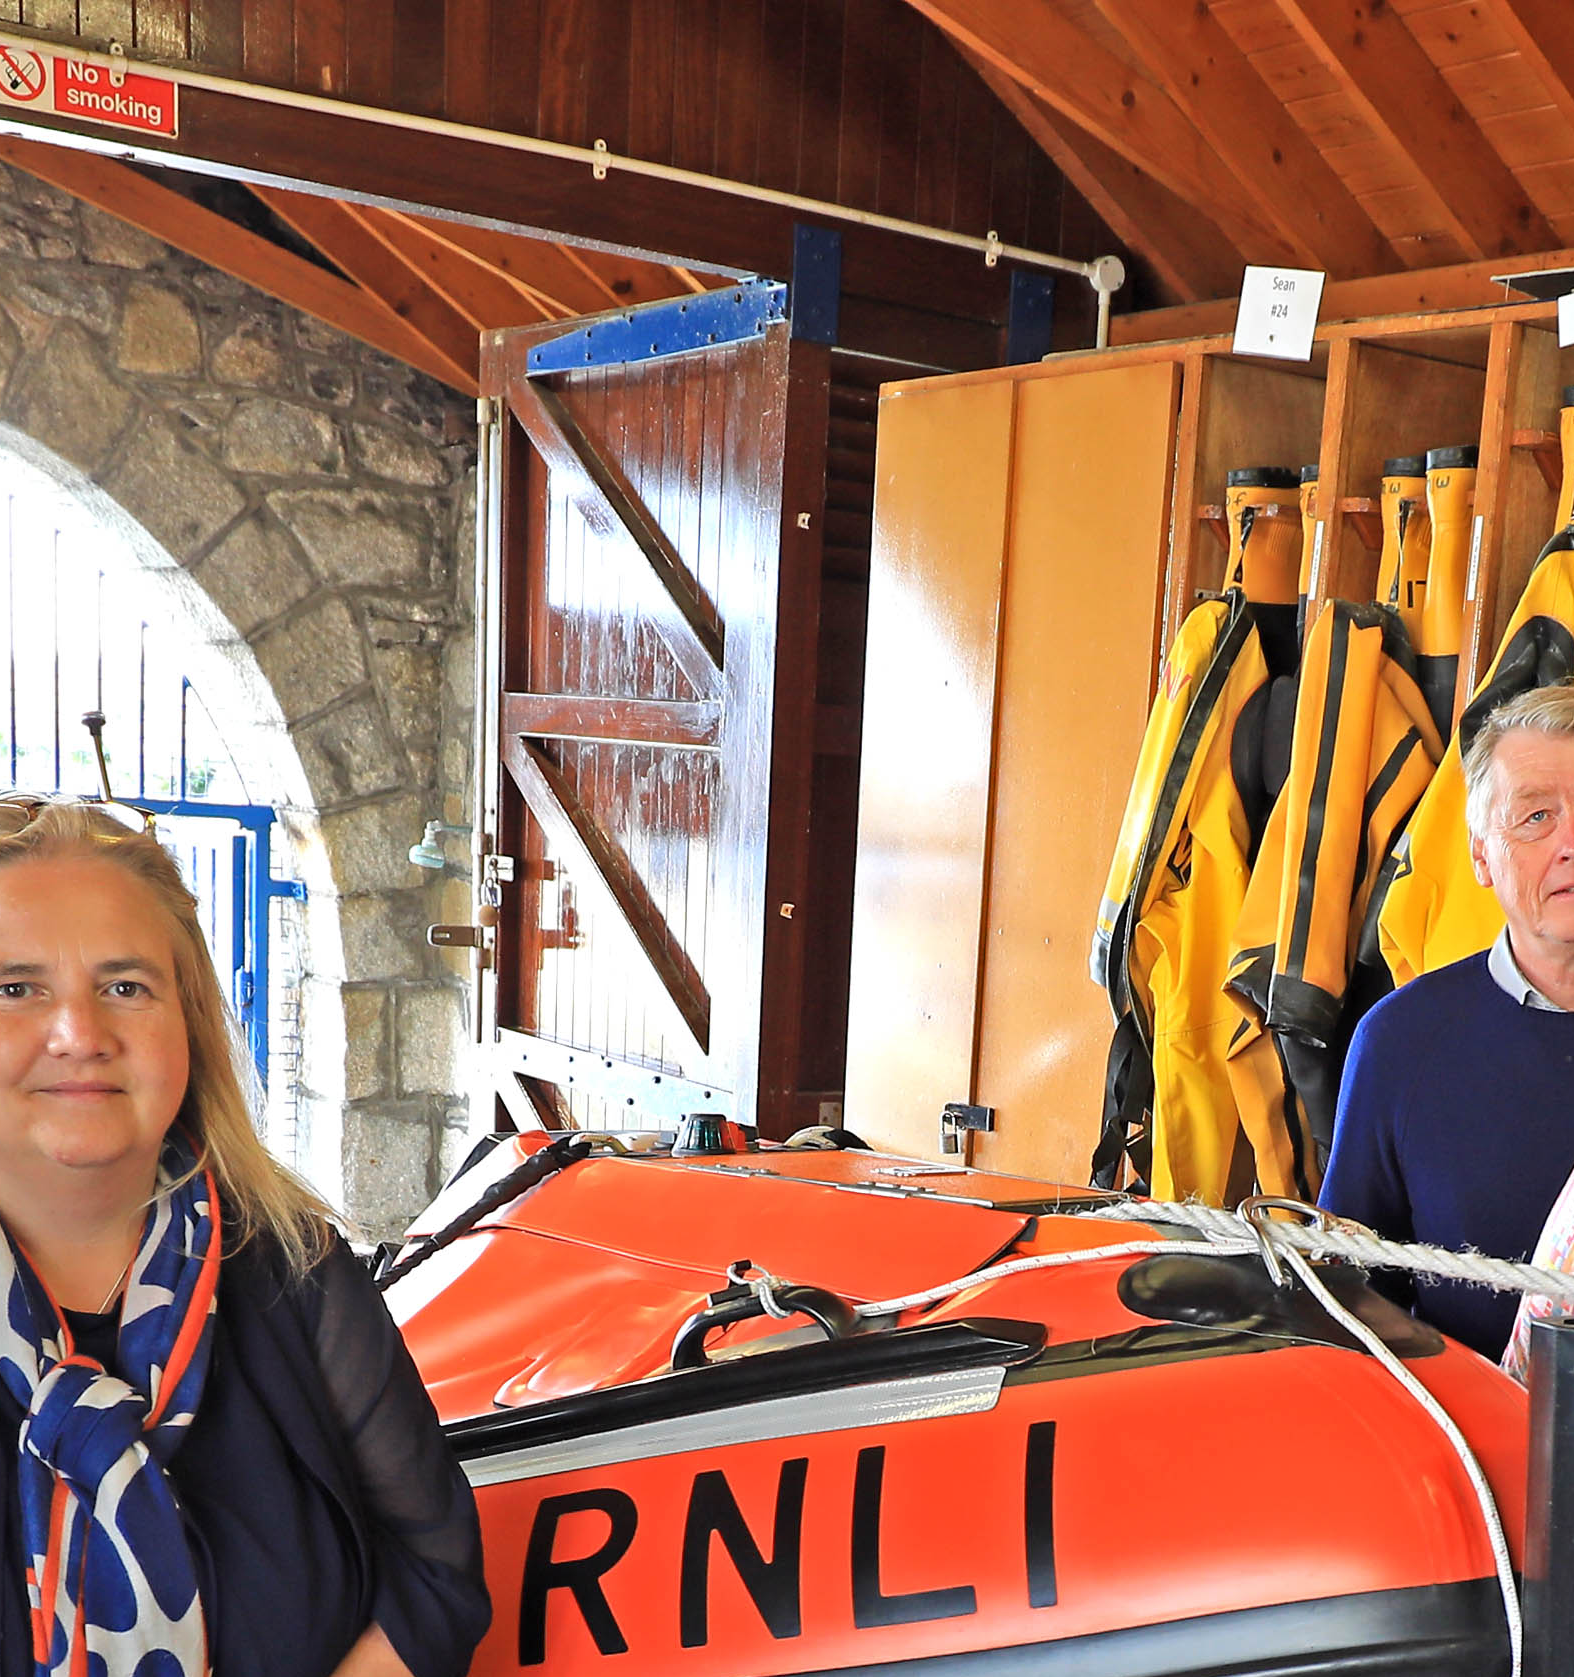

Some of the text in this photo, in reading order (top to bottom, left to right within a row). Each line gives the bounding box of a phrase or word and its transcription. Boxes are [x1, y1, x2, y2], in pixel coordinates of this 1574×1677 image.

[67, 60, 99, 84] No
[67, 88, 161, 126] smoking
[1273, 276, 1295, 292] Sean
[1271, 304, 1288, 318] #24
[518, 1420, 1058, 1667] RNLI
